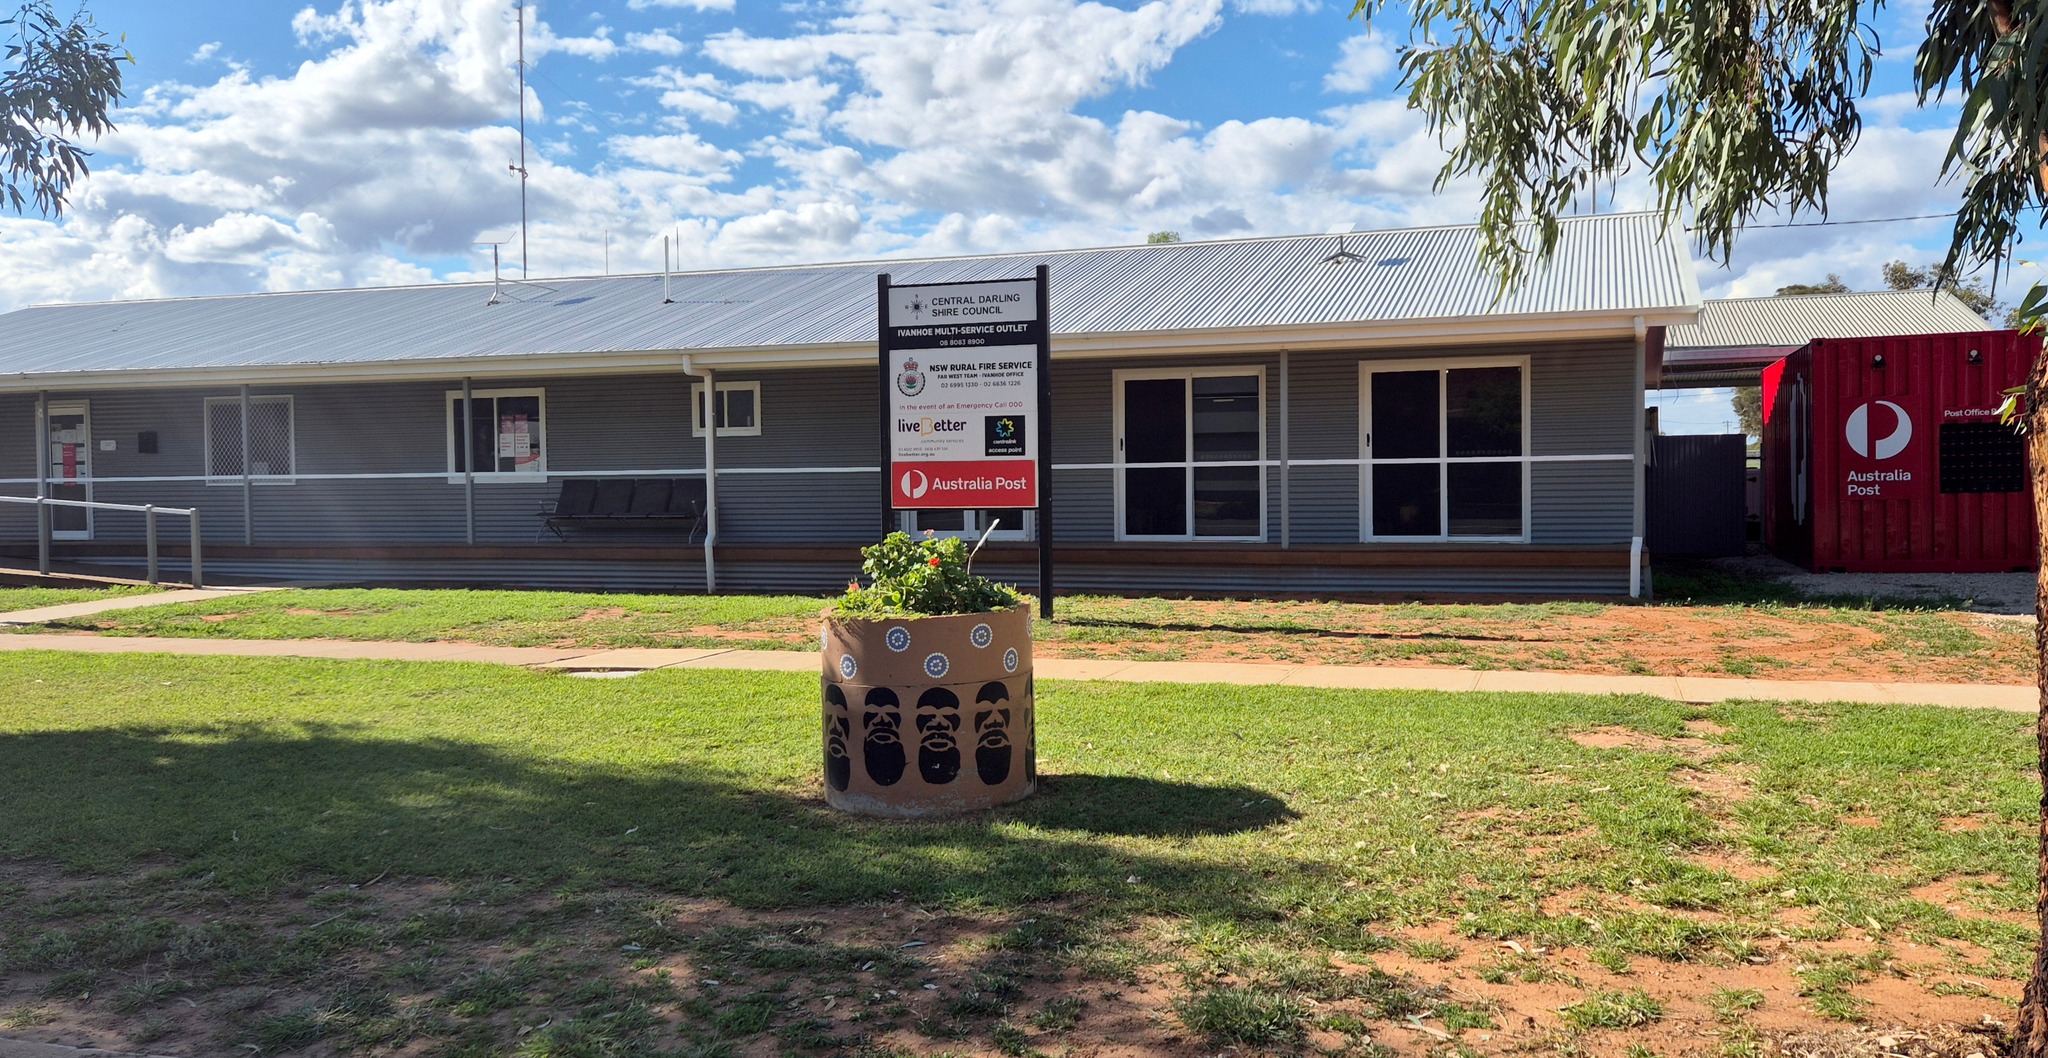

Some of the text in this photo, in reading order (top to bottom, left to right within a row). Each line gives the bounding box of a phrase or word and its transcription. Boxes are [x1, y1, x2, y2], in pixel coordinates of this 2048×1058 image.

[932, 293, 1020, 306] CENTRAL DARLING
[932, 306, 1003, 317] SHIRE COUNCIL
[898, 324, 1028, 337] IVANHOE MULTI-SERVICE OUTLET
[950, 363, 977, 372] RURAL
[998, 361, 1032, 370] SERVICE
[898, 417, 967, 437] liveBetter
[1848, 469, 1912, 482] Australia
[932, 476, 1027, 490] Australia Post
[1848, 484, 1880, 495] Post
